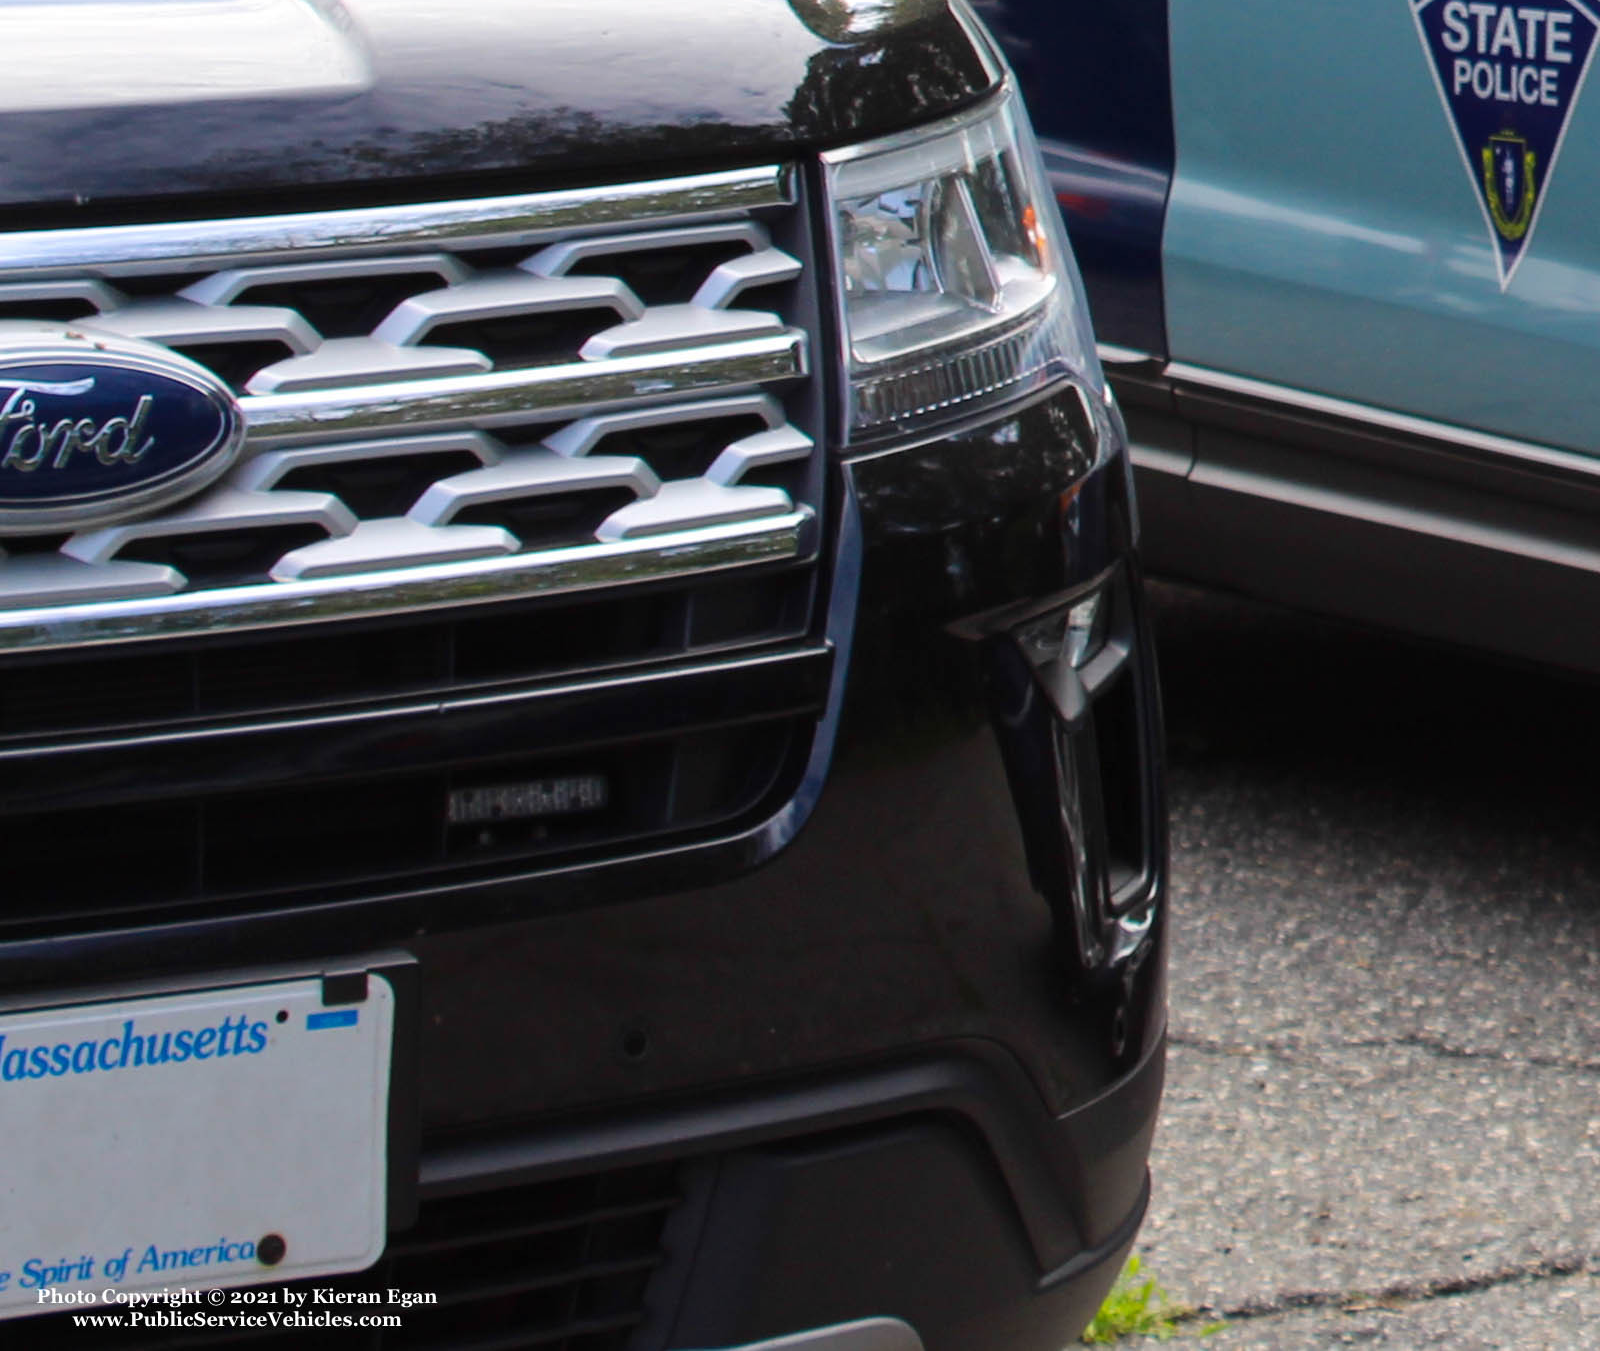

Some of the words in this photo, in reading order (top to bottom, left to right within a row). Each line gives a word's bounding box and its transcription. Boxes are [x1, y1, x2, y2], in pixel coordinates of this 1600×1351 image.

[1441, 0, 1573, 64] STATE
[1453, 59, 1560, 106] POLICE
[0, 1015, 269, 1082] assachusetts
[18, 1252, 95, 1290] Spirit
[102, 1246, 134, 1280] of
[136, 1237, 256, 1274] America
